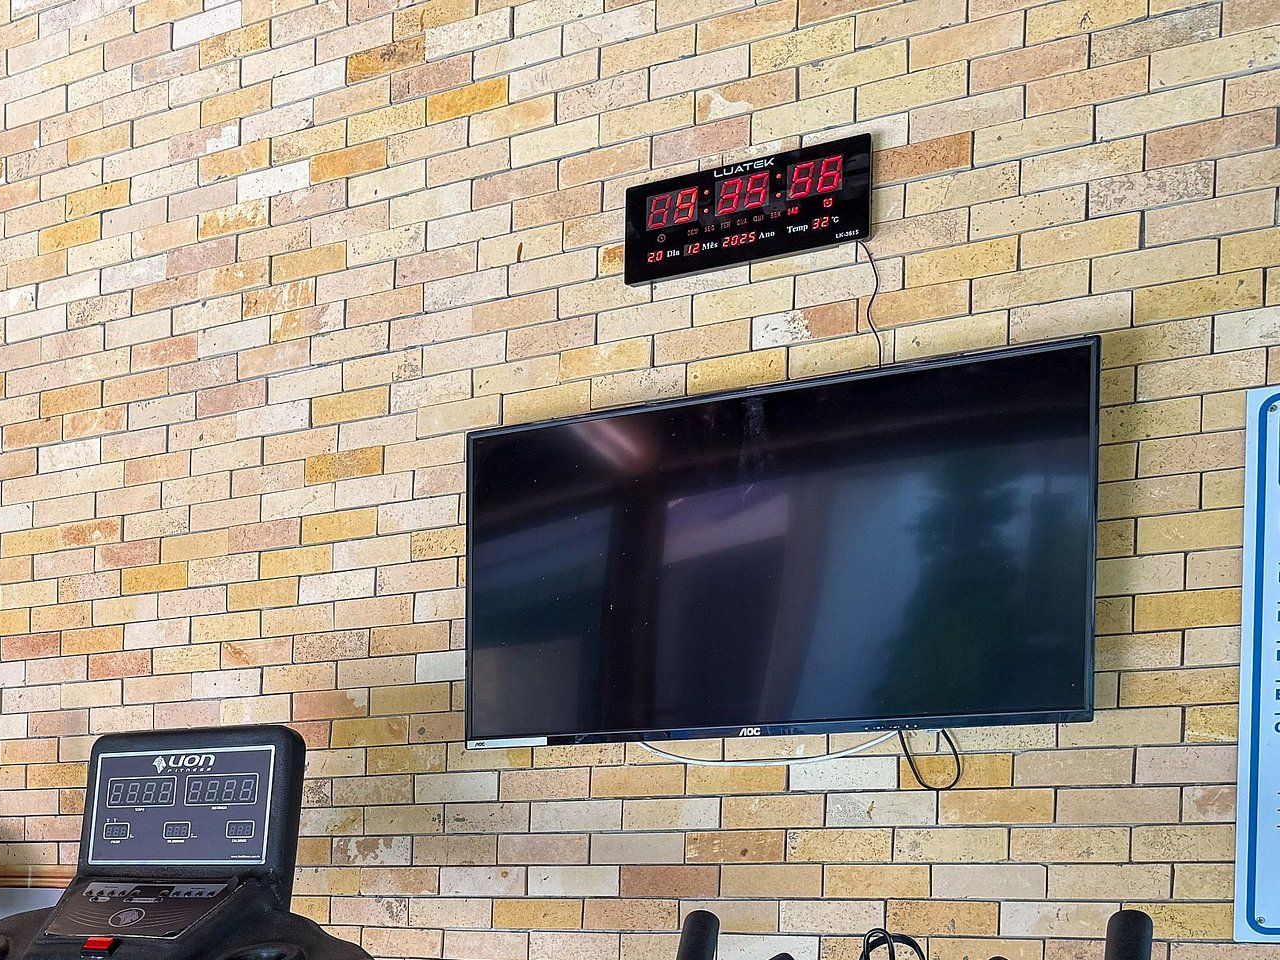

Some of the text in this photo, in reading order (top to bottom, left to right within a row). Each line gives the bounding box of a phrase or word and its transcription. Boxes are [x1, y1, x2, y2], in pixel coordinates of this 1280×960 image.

[713, 157, 775, 178] LUATEK
[647, 250, 664, 263] 20
[666, 249, 680, 258] Dia
[687, 242, 701, 255] 12
[702, 240, 719, 251] Mês
[722, 231, 757, 248] 2025
[758, 231, 776, 240] Ano
[786, 223, 809, 233] Temp
[811, 215, 830, 230] 32
[738, 727, 761, 737] AOC
[168, 753, 216, 768] LION
